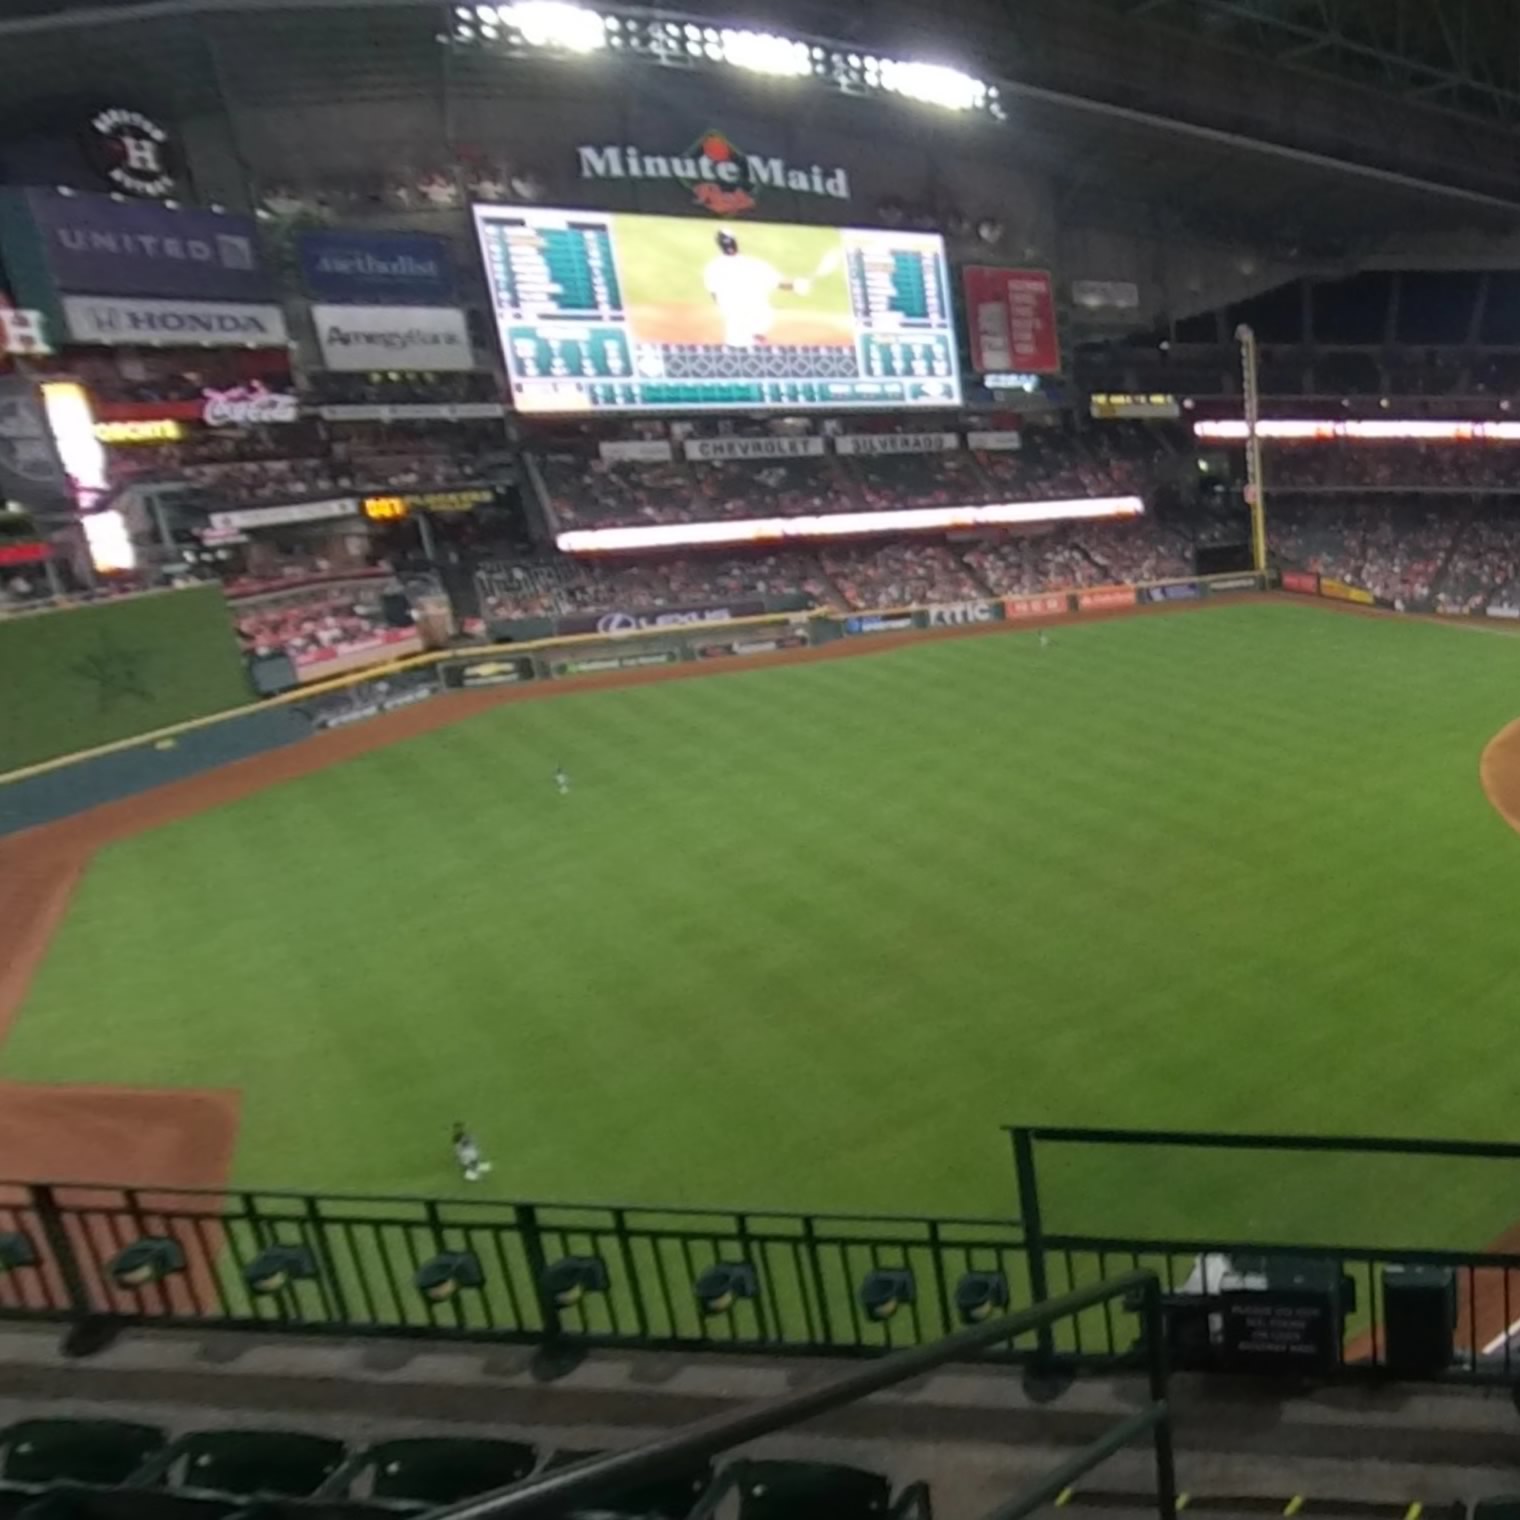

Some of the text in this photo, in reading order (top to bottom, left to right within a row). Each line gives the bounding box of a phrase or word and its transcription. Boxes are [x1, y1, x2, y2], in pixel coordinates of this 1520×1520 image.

[578, 145, 849, 199] Minute Maid
[57, 228, 212, 262] UNITED
[125, 310, 267, 333] HONDA
[699, 440, 811, 458] CHEVROLET
[851, 435, 945, 455] SILVERADO
[638, 607, 732, 629] LEXUS
